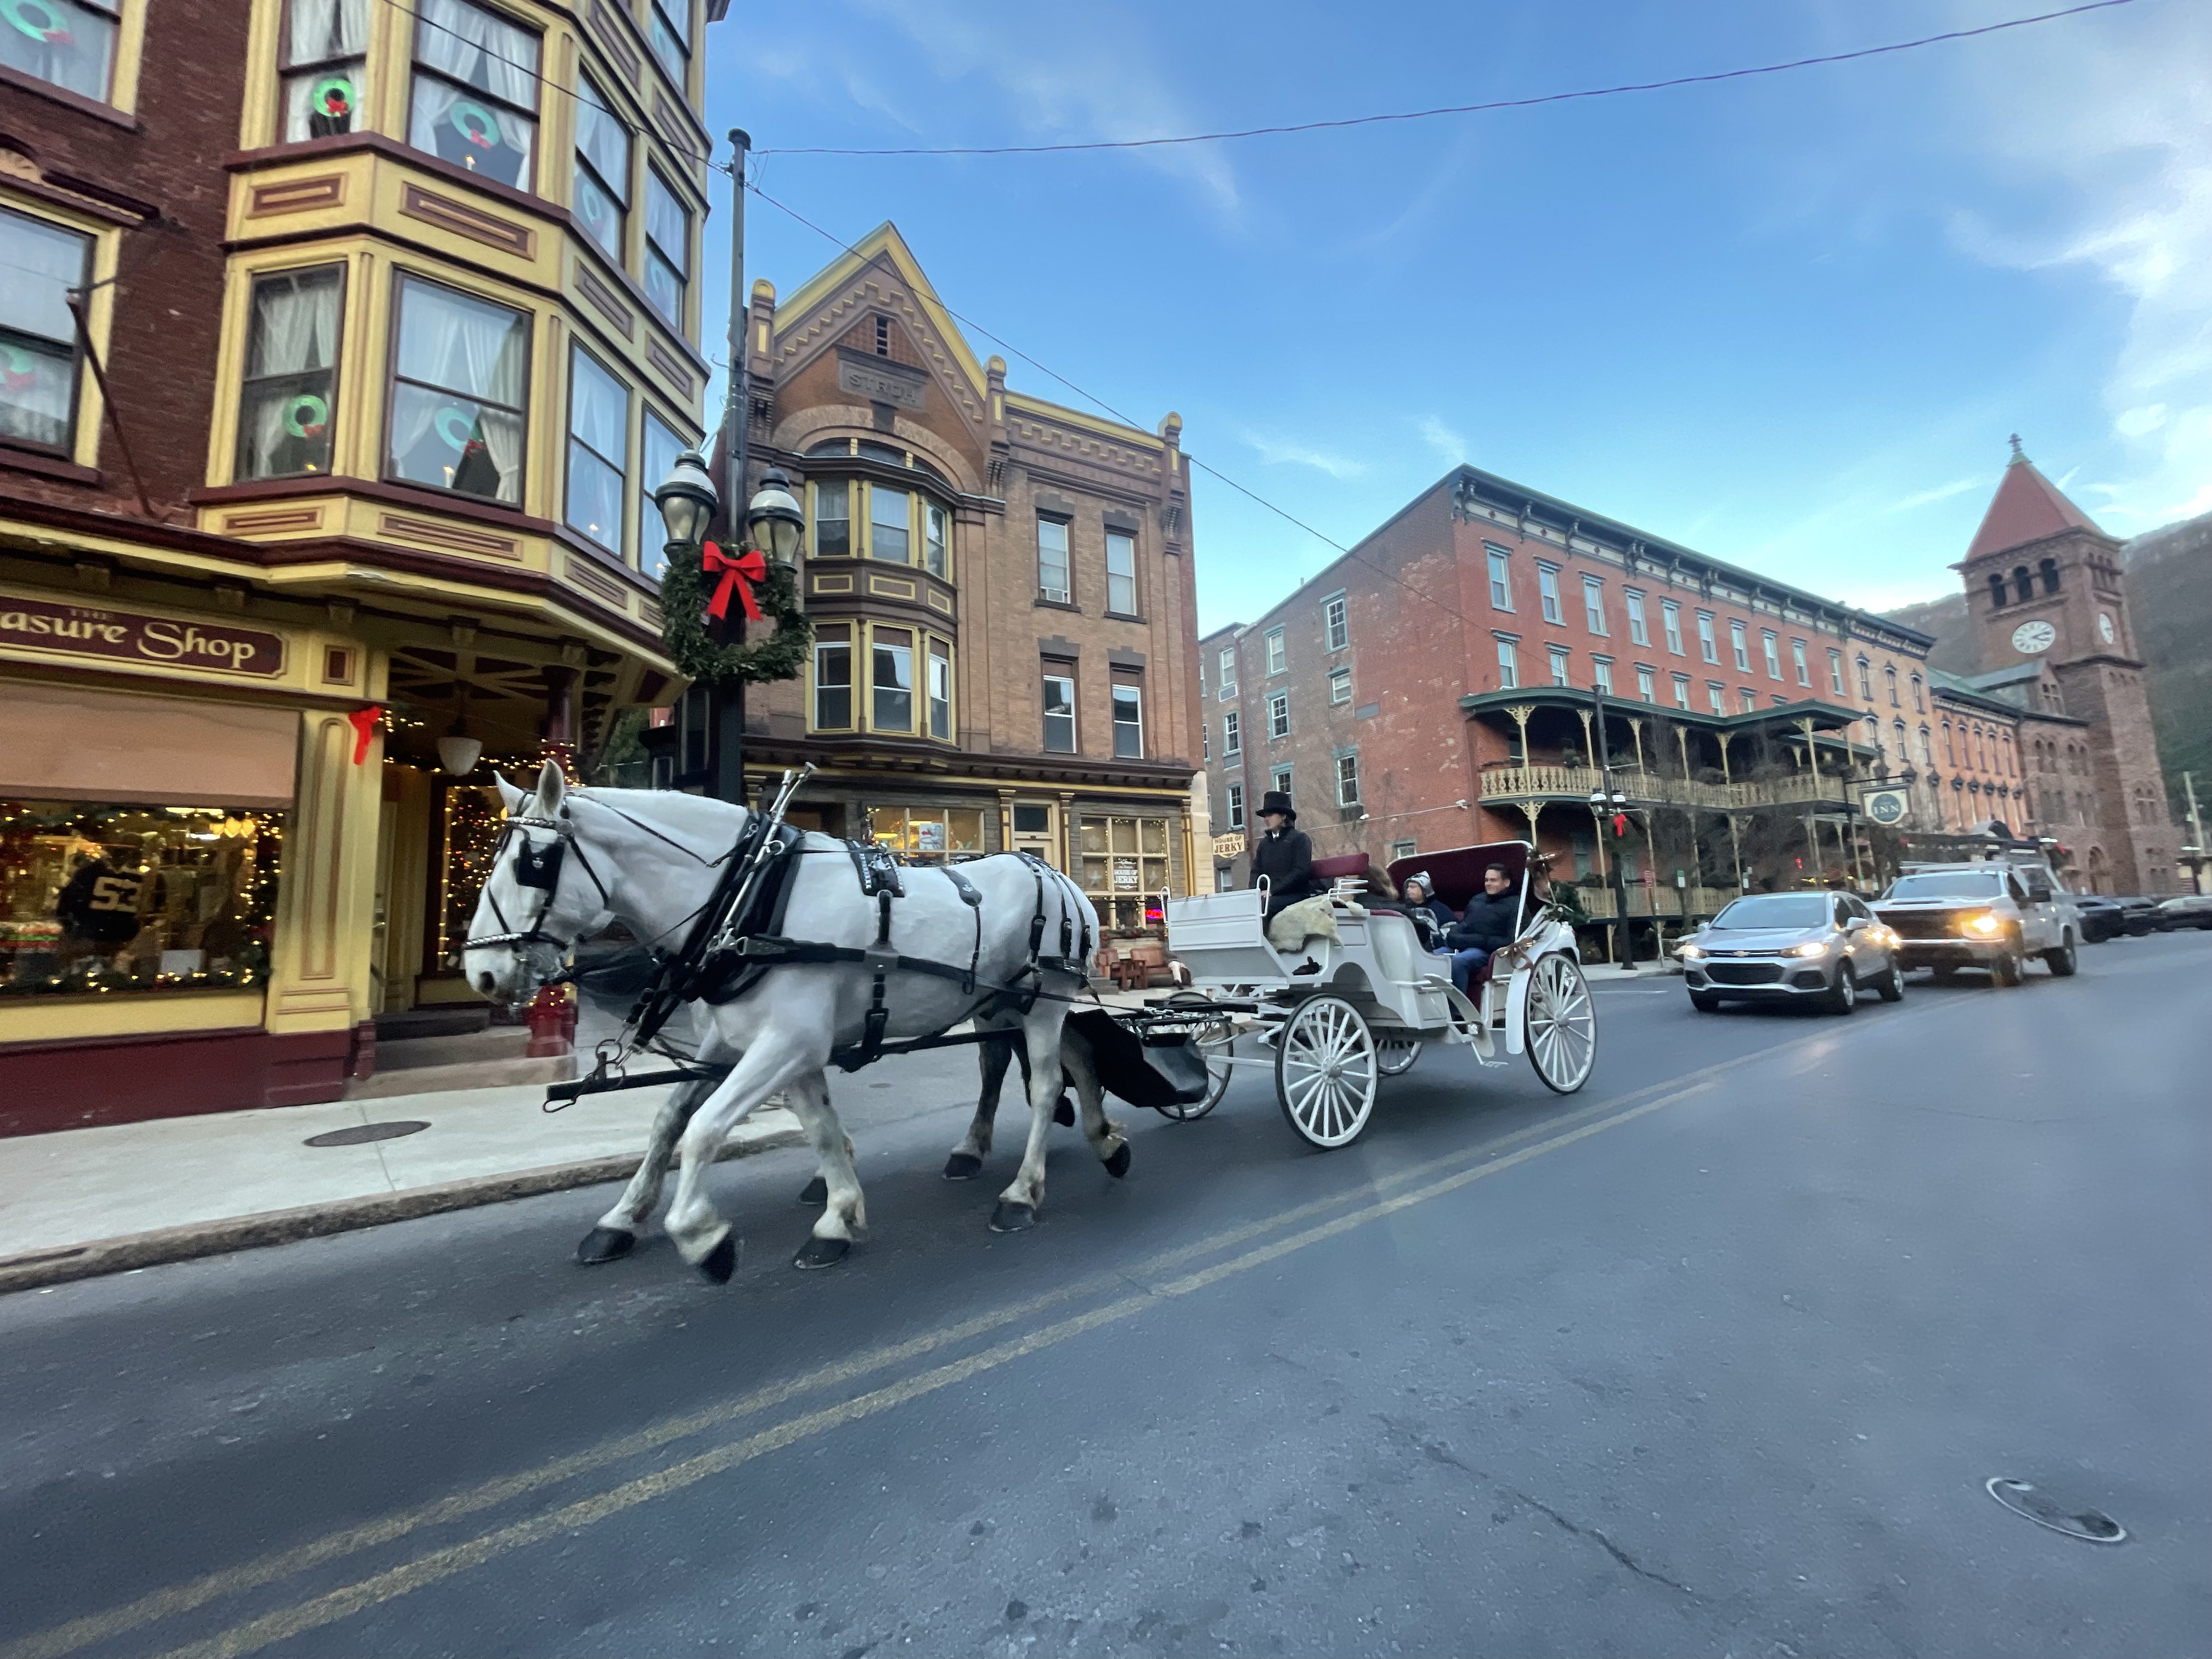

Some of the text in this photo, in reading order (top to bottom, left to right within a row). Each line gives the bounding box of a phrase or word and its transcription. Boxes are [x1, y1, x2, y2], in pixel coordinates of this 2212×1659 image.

[138, 622, 255, 669] Shop
[1873, 804, 1899, 814] INN
[1214, 842, 1243, 853] JERKY
